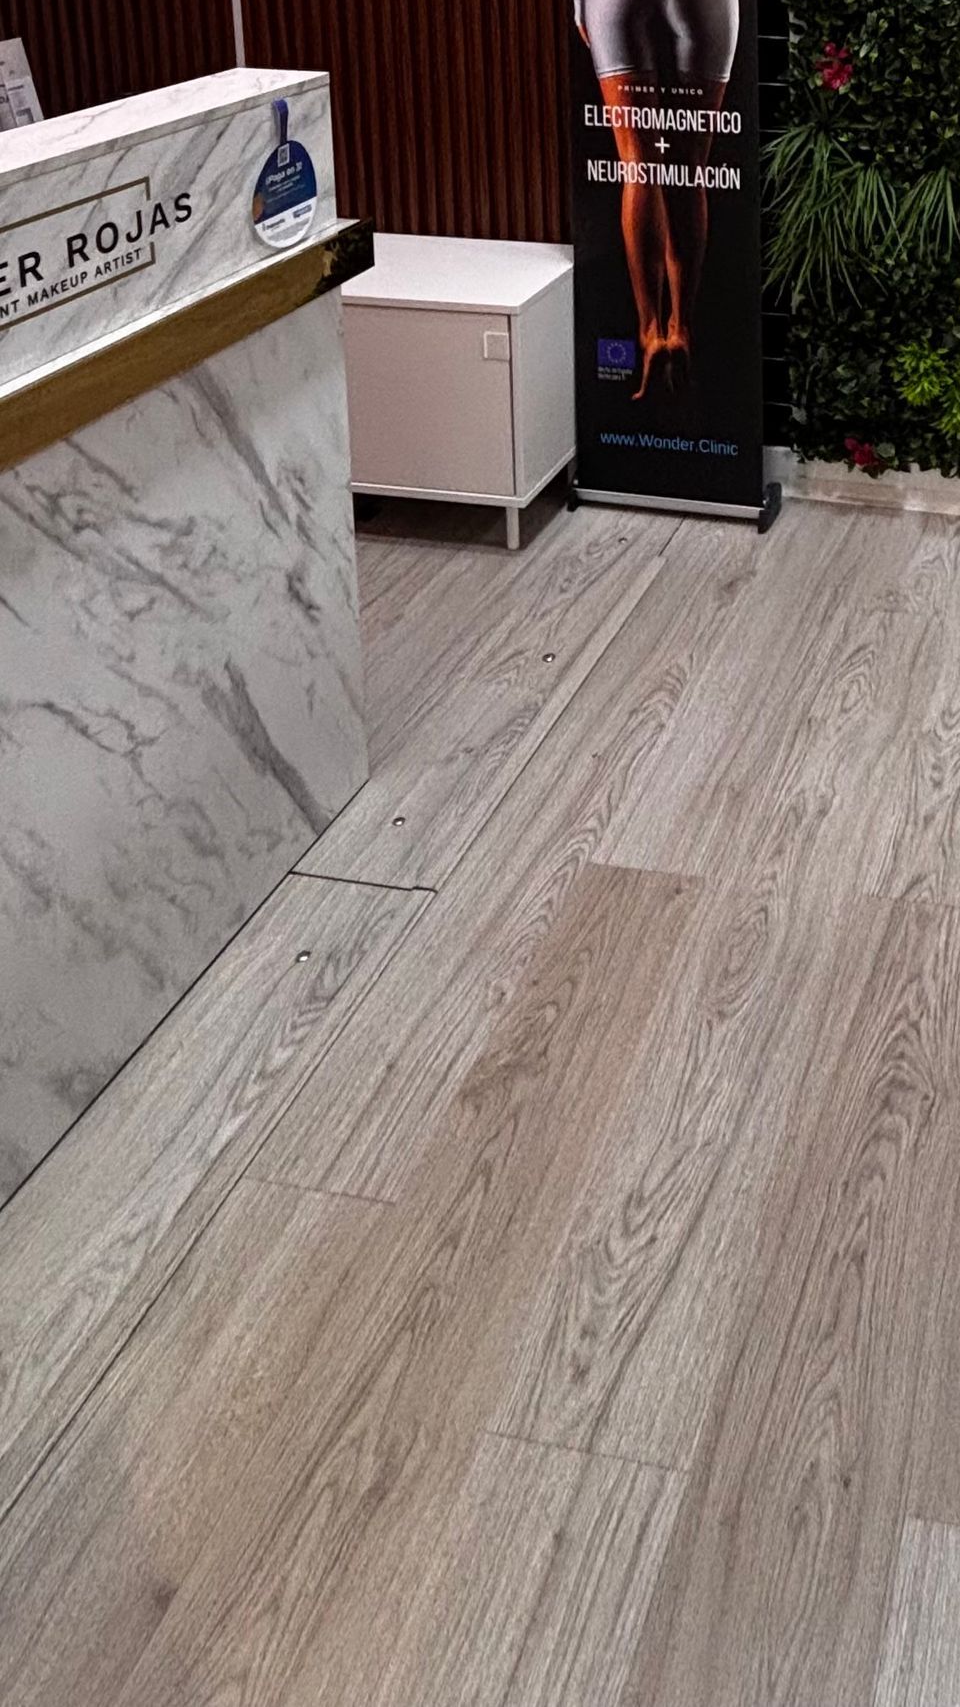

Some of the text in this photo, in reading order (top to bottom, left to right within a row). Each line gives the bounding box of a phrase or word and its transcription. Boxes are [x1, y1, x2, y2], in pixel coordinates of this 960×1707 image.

[584, 104, 742, 134] ELECTROMAGNETICO
[587, 159, 741, 190] NEUROSTIMULACIÓN
[66, 193, 192, 268] ROJAS
[27, 271, 88, 307] MAKEUP
[94, 248, 142, 278] ARTIST
